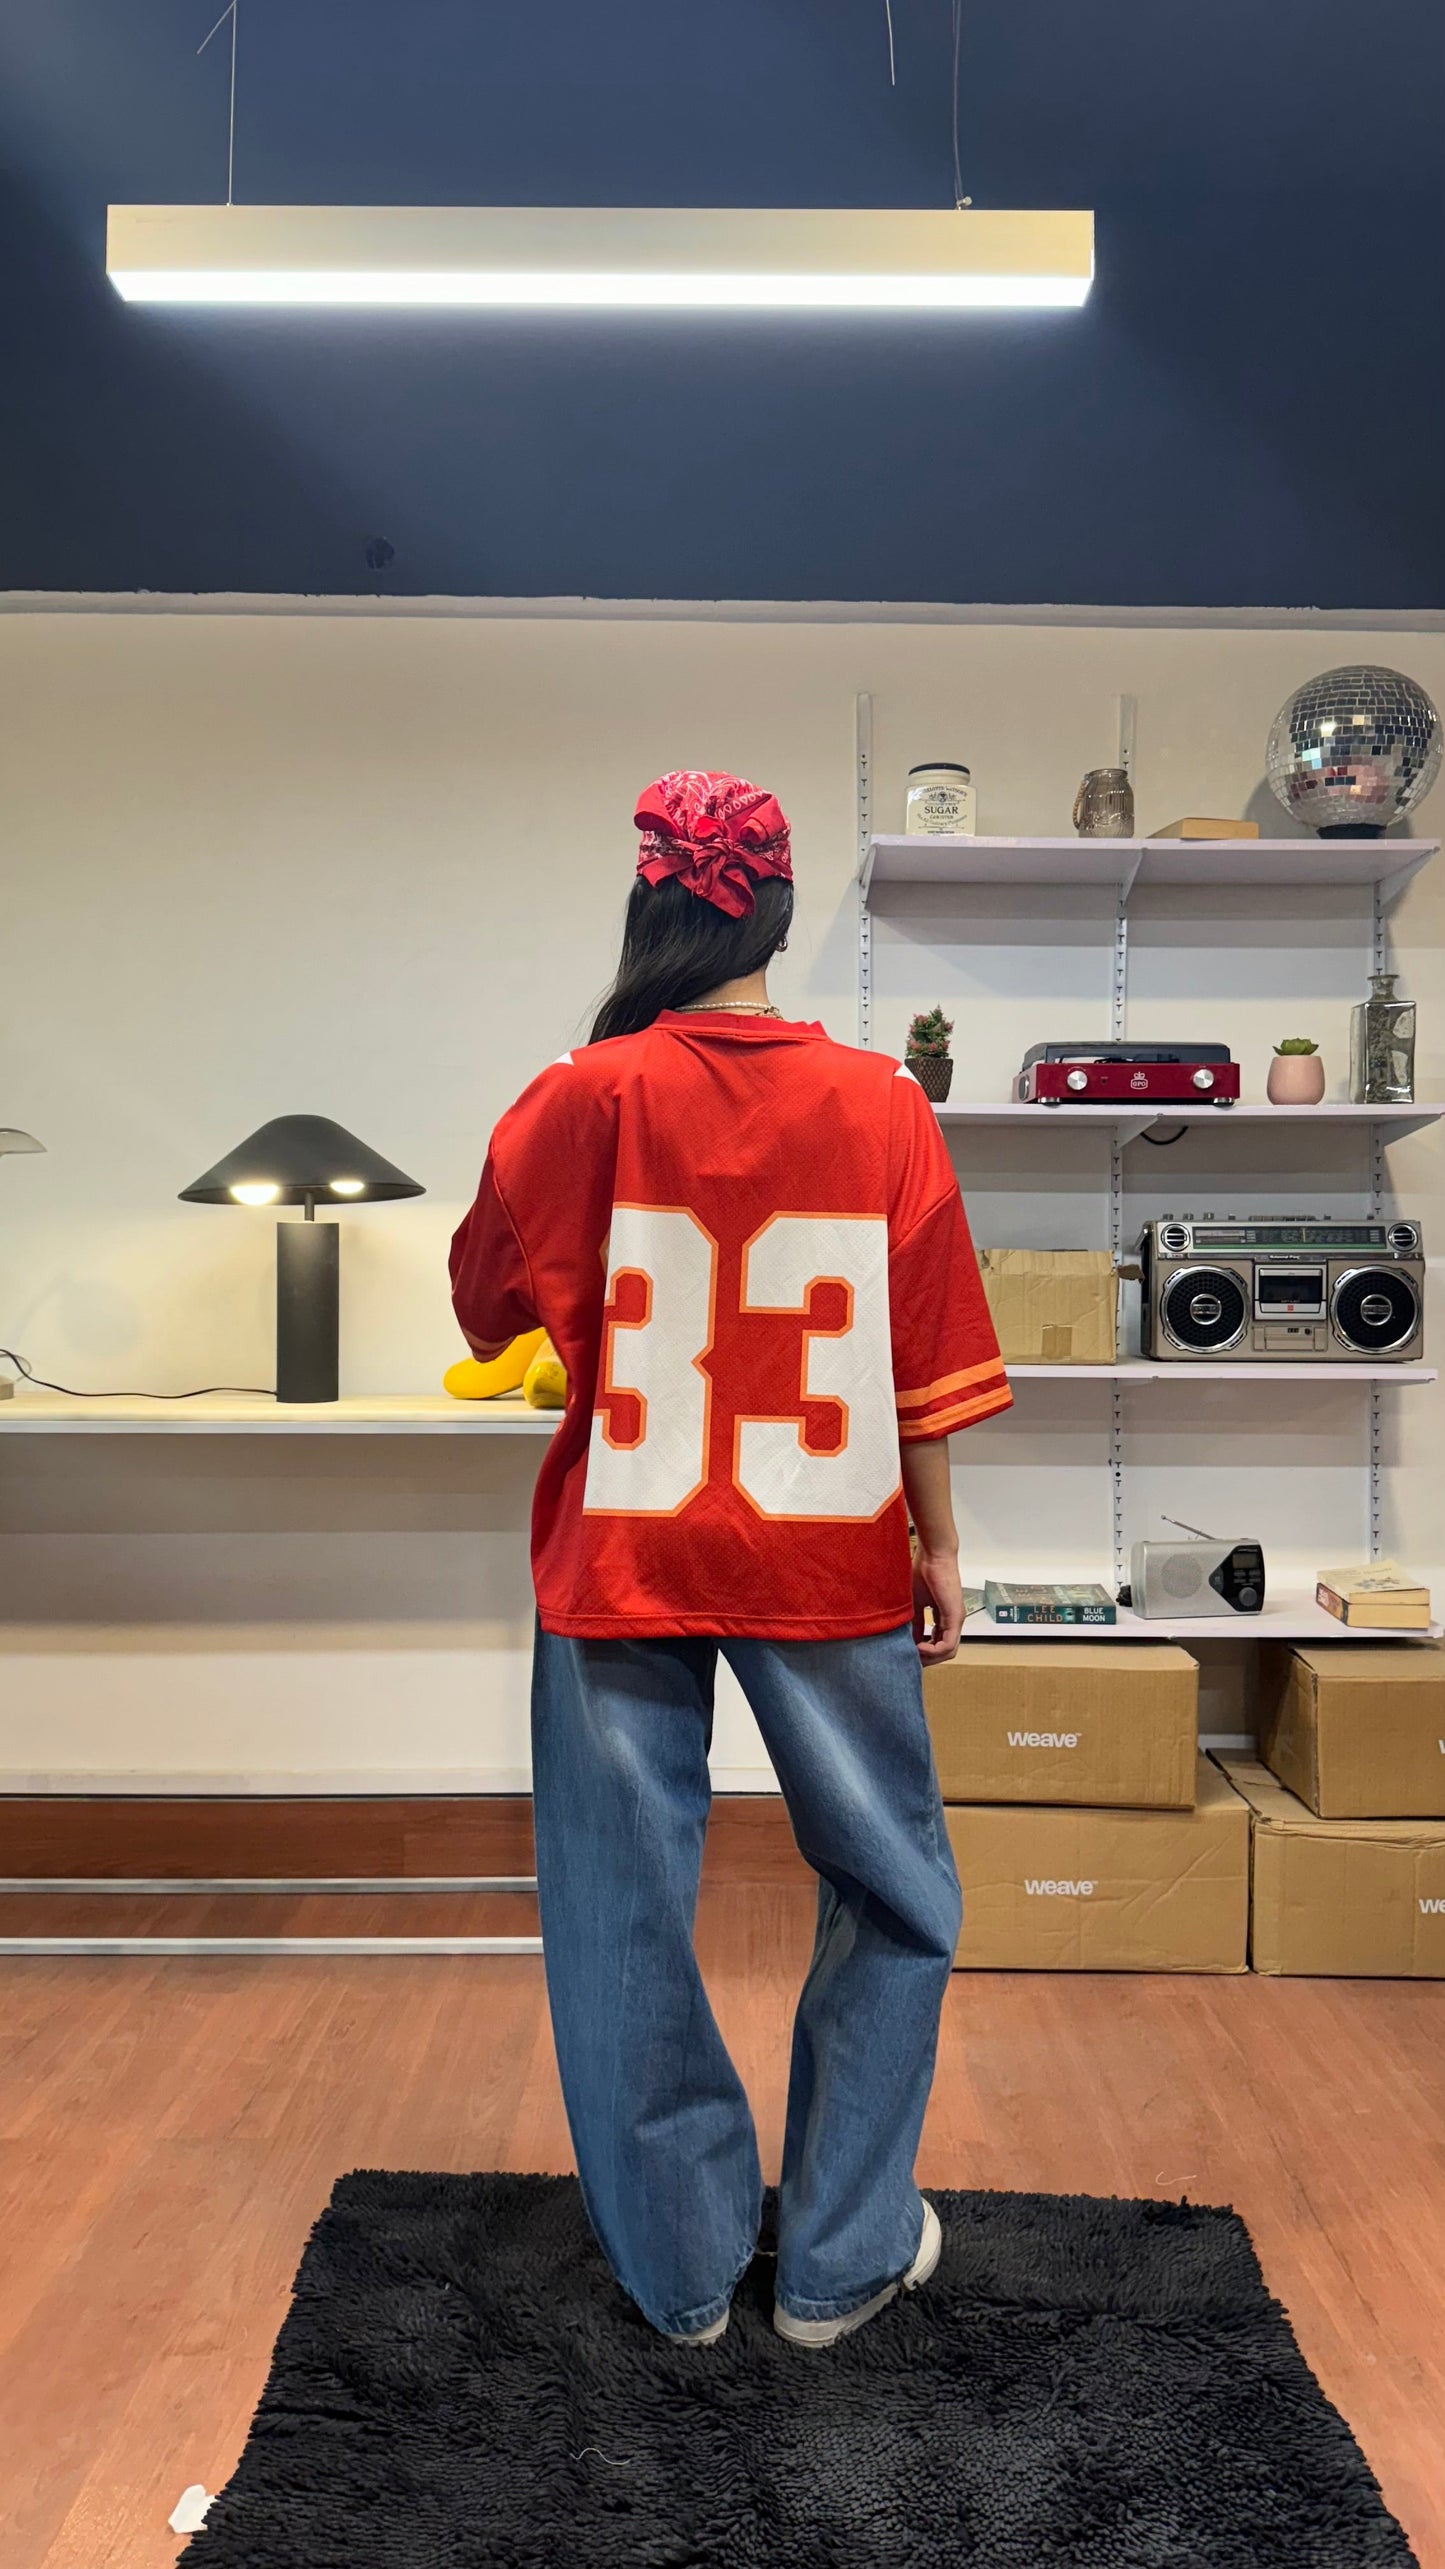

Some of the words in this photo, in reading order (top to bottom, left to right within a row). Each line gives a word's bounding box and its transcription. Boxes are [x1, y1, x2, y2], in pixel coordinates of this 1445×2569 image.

[924, 806, 959, 814] SUGAR
[583, 1201, 903, 1523] 33
[1033, 1604, 1056, 1613] LEE
[1083, 1607, 1104, 1615] BLUE
[1027, 1614, 1063, 1622] CHILD
[1082, 1614, 1106, 1622] MOON
